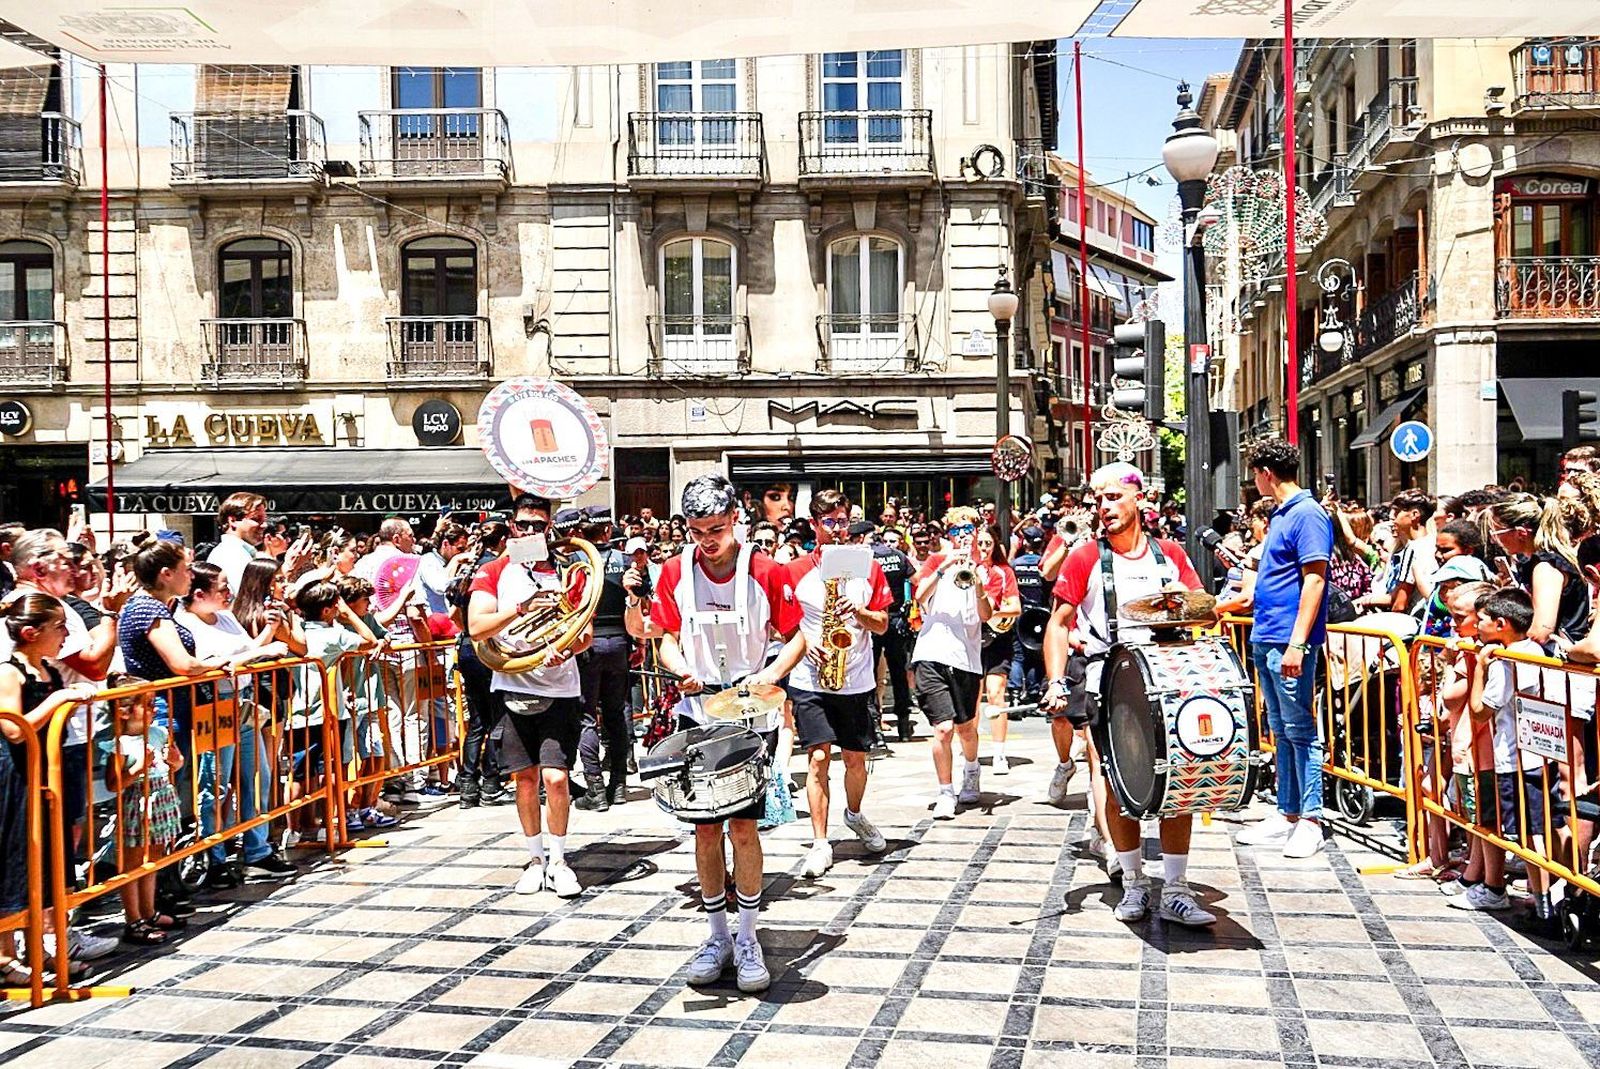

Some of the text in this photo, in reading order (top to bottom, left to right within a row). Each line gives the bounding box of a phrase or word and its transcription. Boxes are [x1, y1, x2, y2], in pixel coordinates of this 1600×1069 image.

[1525, 179, 1589, 195] Coreal
[144, 413, 323, 438] LA CUEVA
[423, 413, 449, 424] LCV
[118, 496, 149, 512] LA
[152, 494, 221, 512] CUEVA
[339, 494, 368, 511] LA
[371, 494, 441, 511] CUEVA
[466, 499, 496, 510] 1900
[881, 564, 900, 572] OCAL
[1531, 720, 1565, 740] GRANADA
